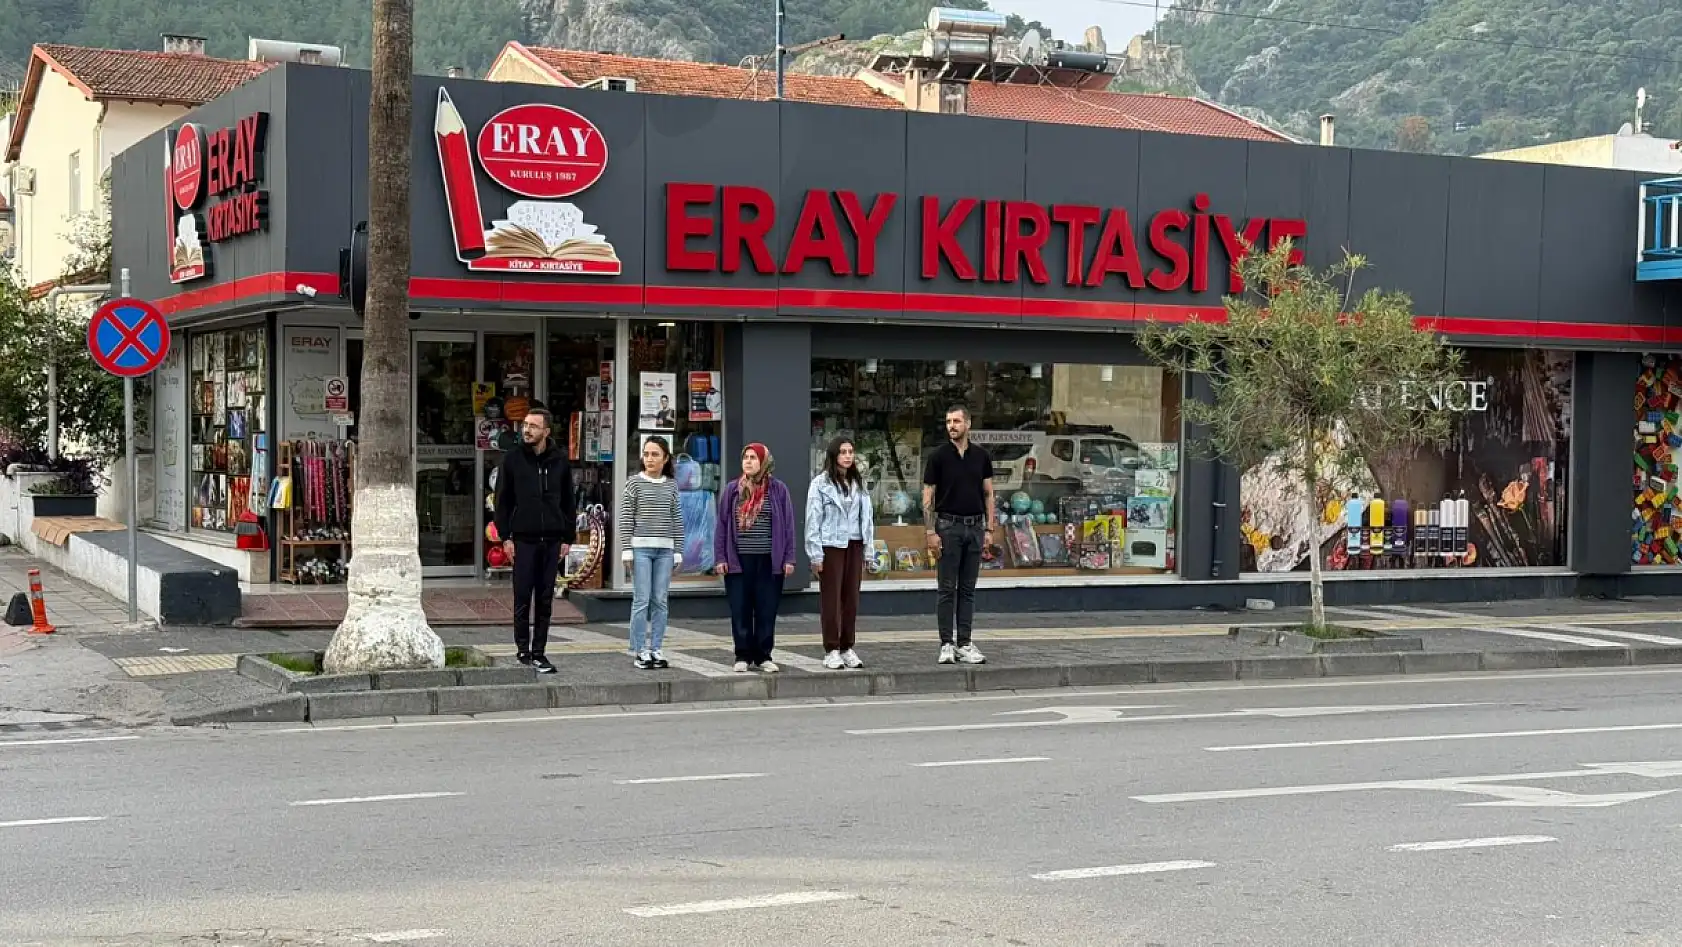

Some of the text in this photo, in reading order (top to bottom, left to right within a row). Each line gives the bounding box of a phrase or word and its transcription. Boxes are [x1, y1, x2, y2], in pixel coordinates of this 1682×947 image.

[492, 122, 594, 158] ERAY
[208, 112, 258, 196] ERAY
[510, 169, 577, 181] KURULUŞ 1987
[666, 182, 898, 277] ERAY
[509, 259, 534, 269] KİTAP
[292, 337, 331, 348] ERAY
